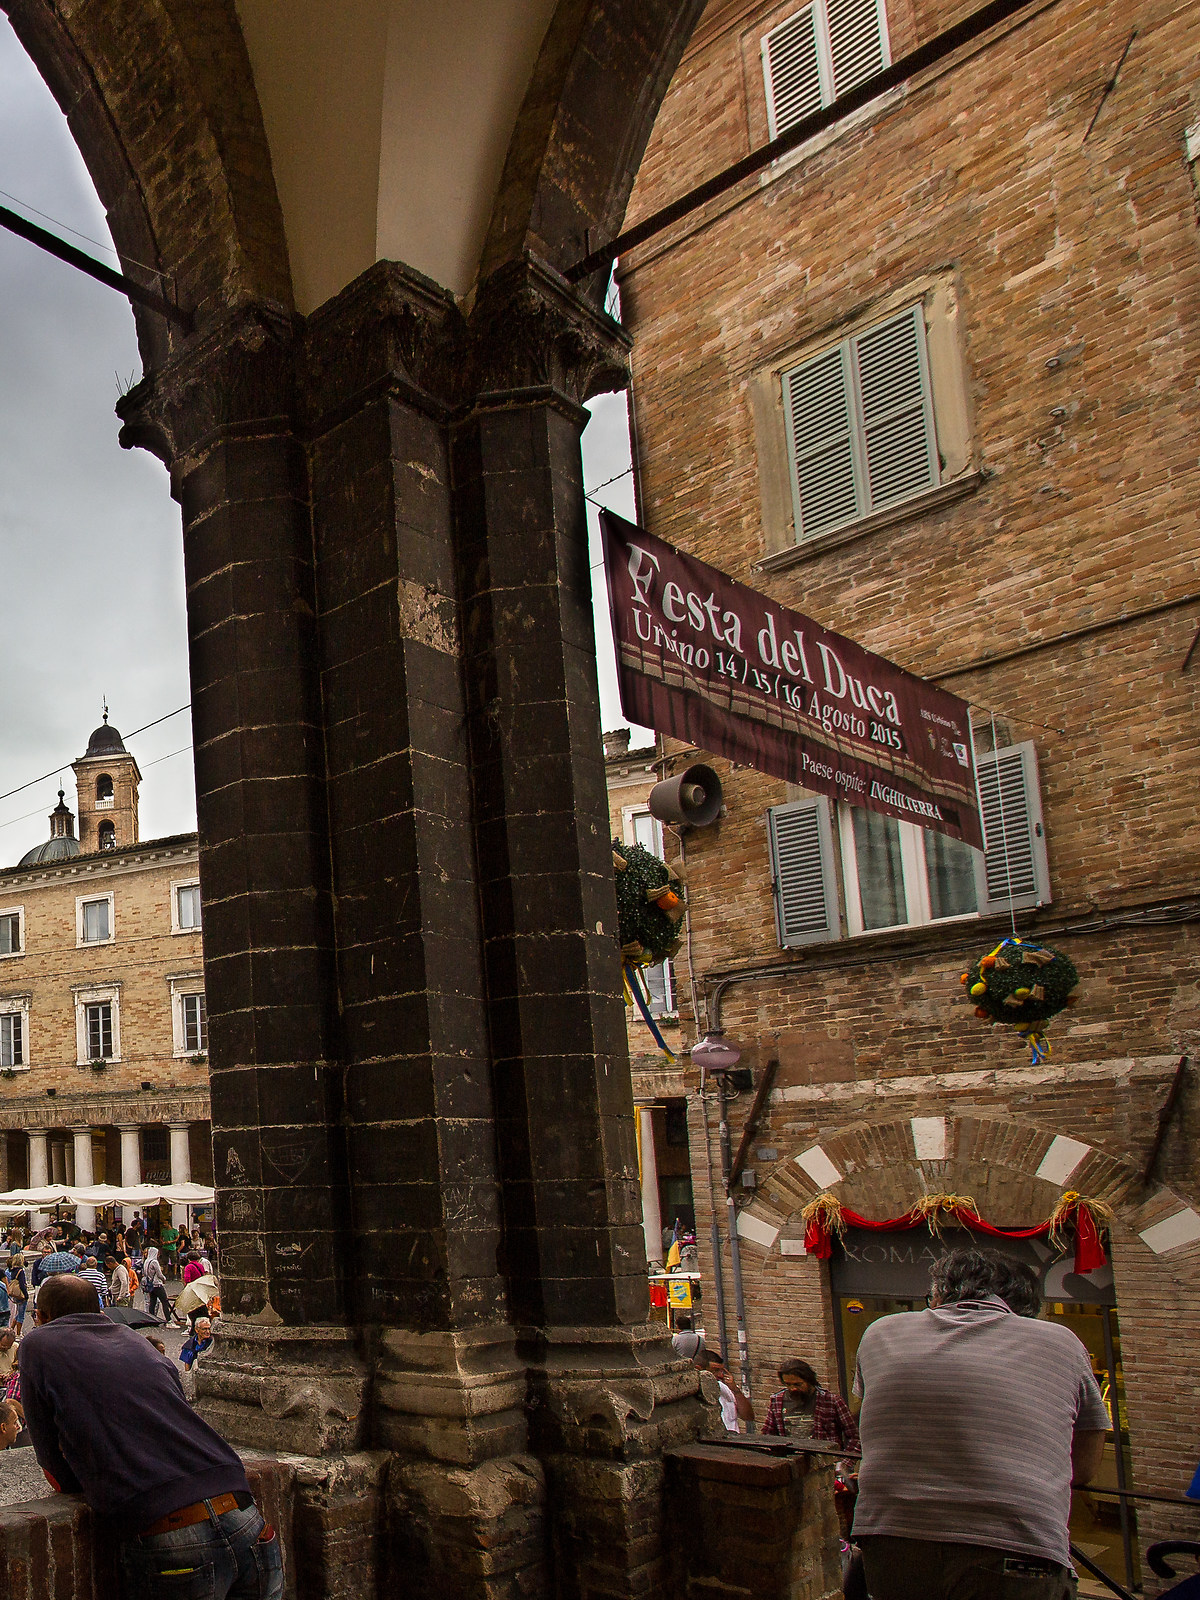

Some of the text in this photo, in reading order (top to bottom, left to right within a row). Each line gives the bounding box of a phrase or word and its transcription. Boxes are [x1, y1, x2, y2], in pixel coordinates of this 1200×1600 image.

[626, 542, 901, 726] Festa del Duca
[632, 608, 709, 669] Urbino
[808, 691, 866, 738] Agosto
[870, 721, 902, 750] 2015
[801, 752, 943, 821] Paese ospite: INGHILTERRA
